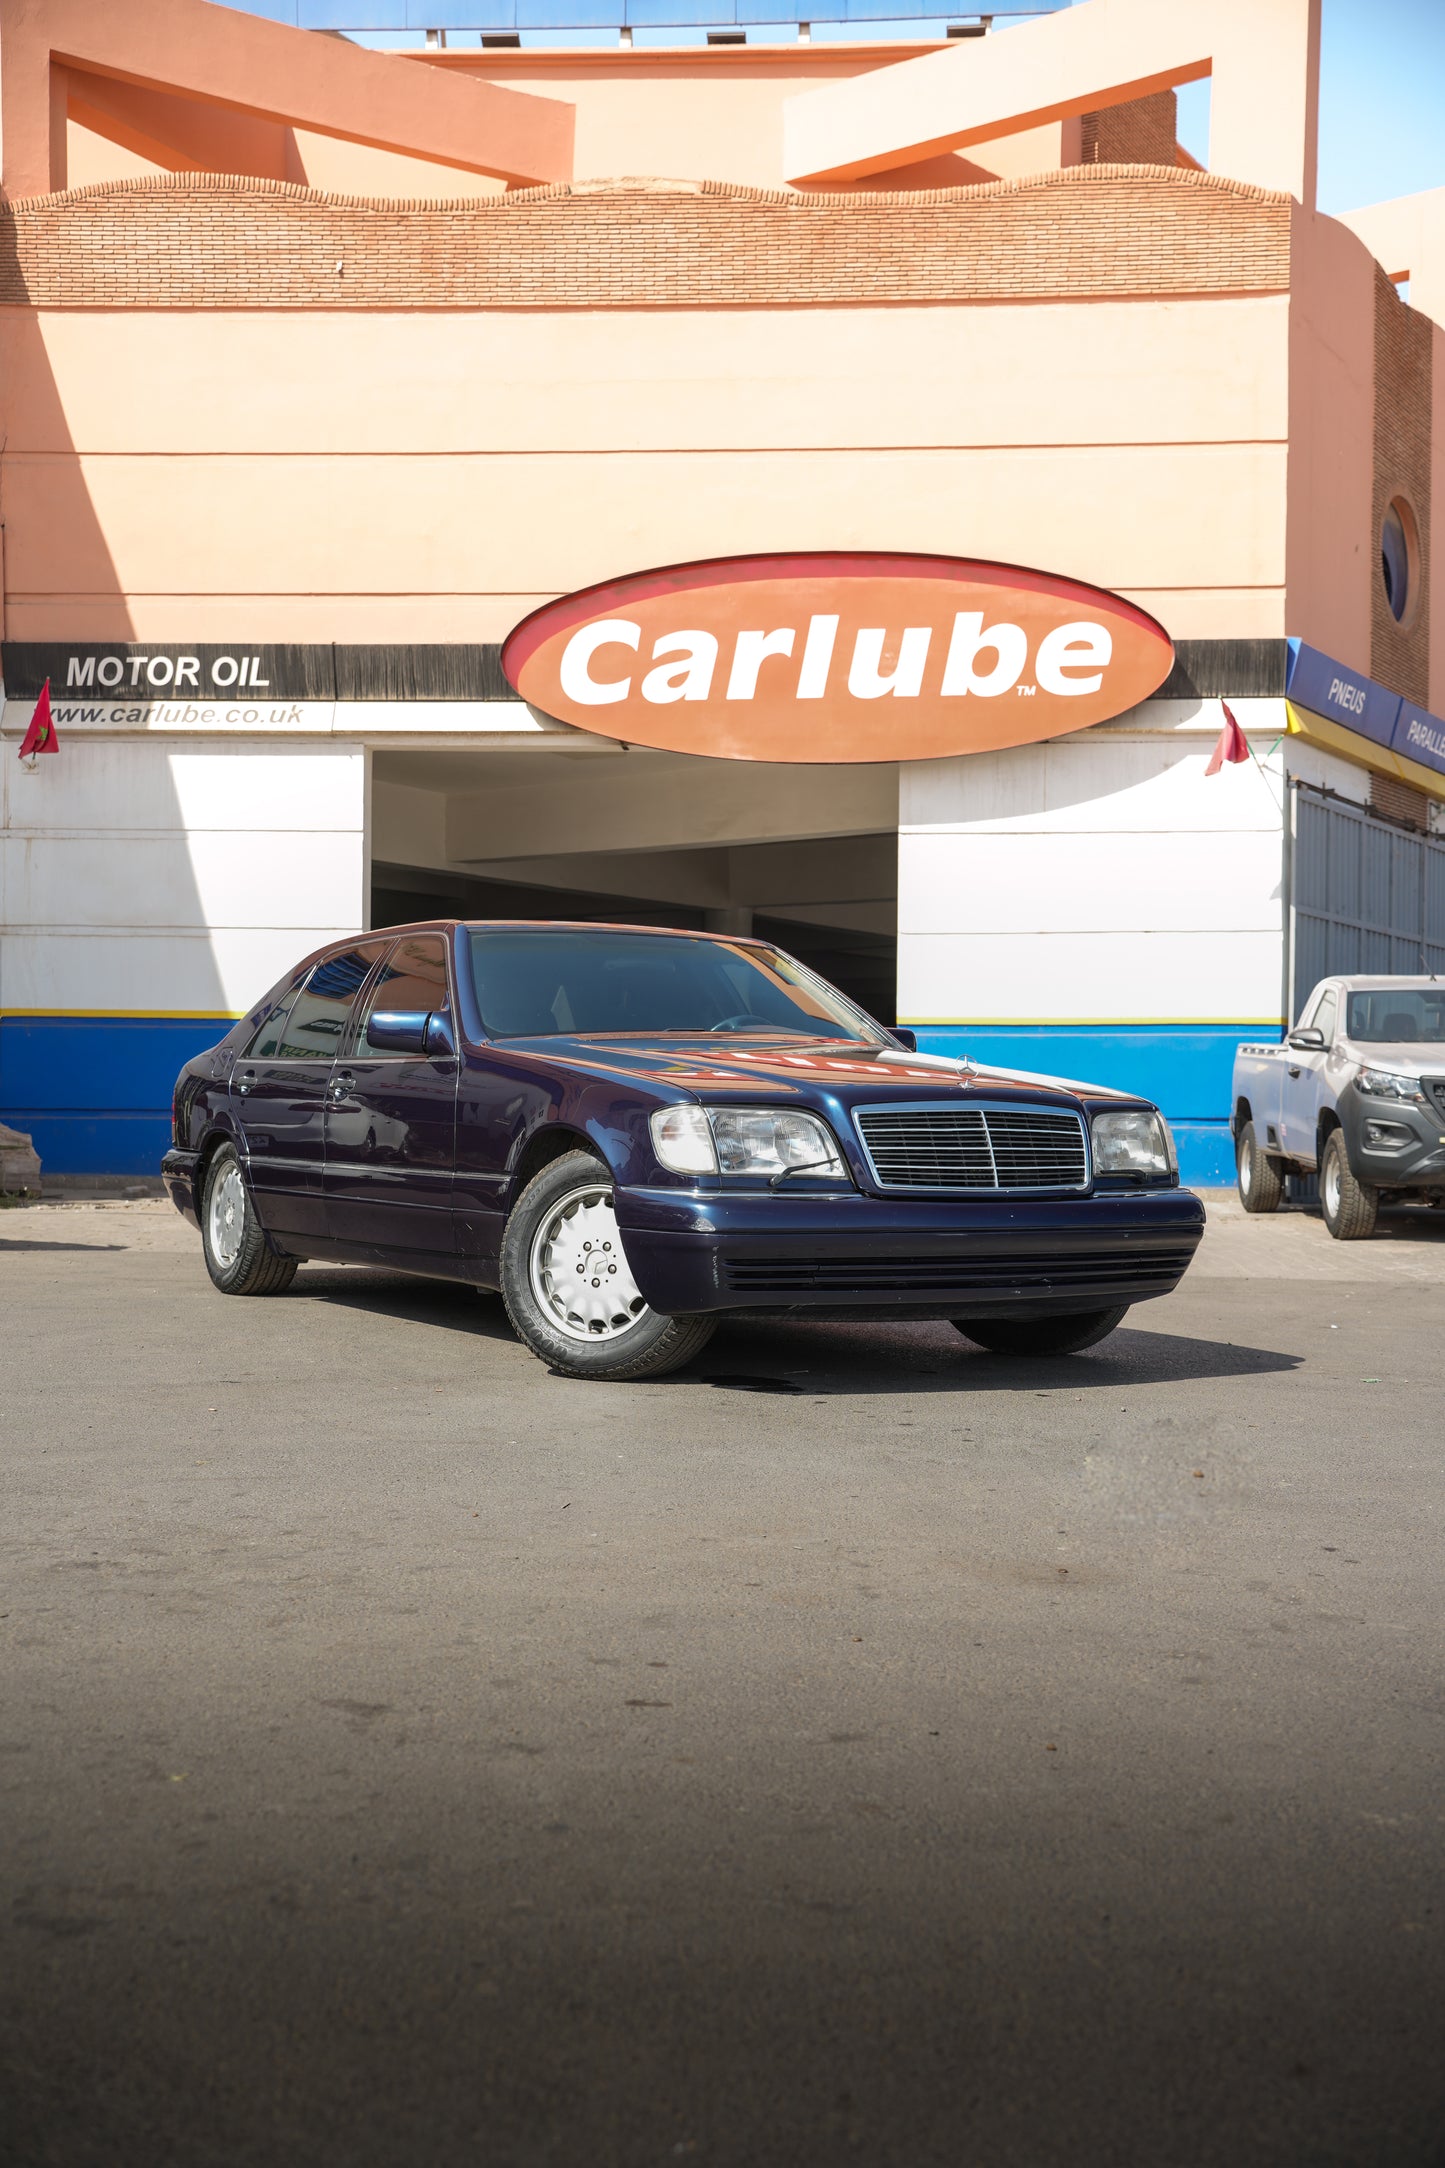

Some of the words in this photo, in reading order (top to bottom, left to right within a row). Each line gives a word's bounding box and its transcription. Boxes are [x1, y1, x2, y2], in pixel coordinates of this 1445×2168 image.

[66, 657, 200, 687] MOTOR
[211, 657, 270, 687] OIL
[559, 611, 1113, 706] Carlube
[1016, 684, 1037, 697] TM
[1328, 679, 1366, 714] PNEUS
[36, 704, 303, 724] ww.carlube.co.uk
